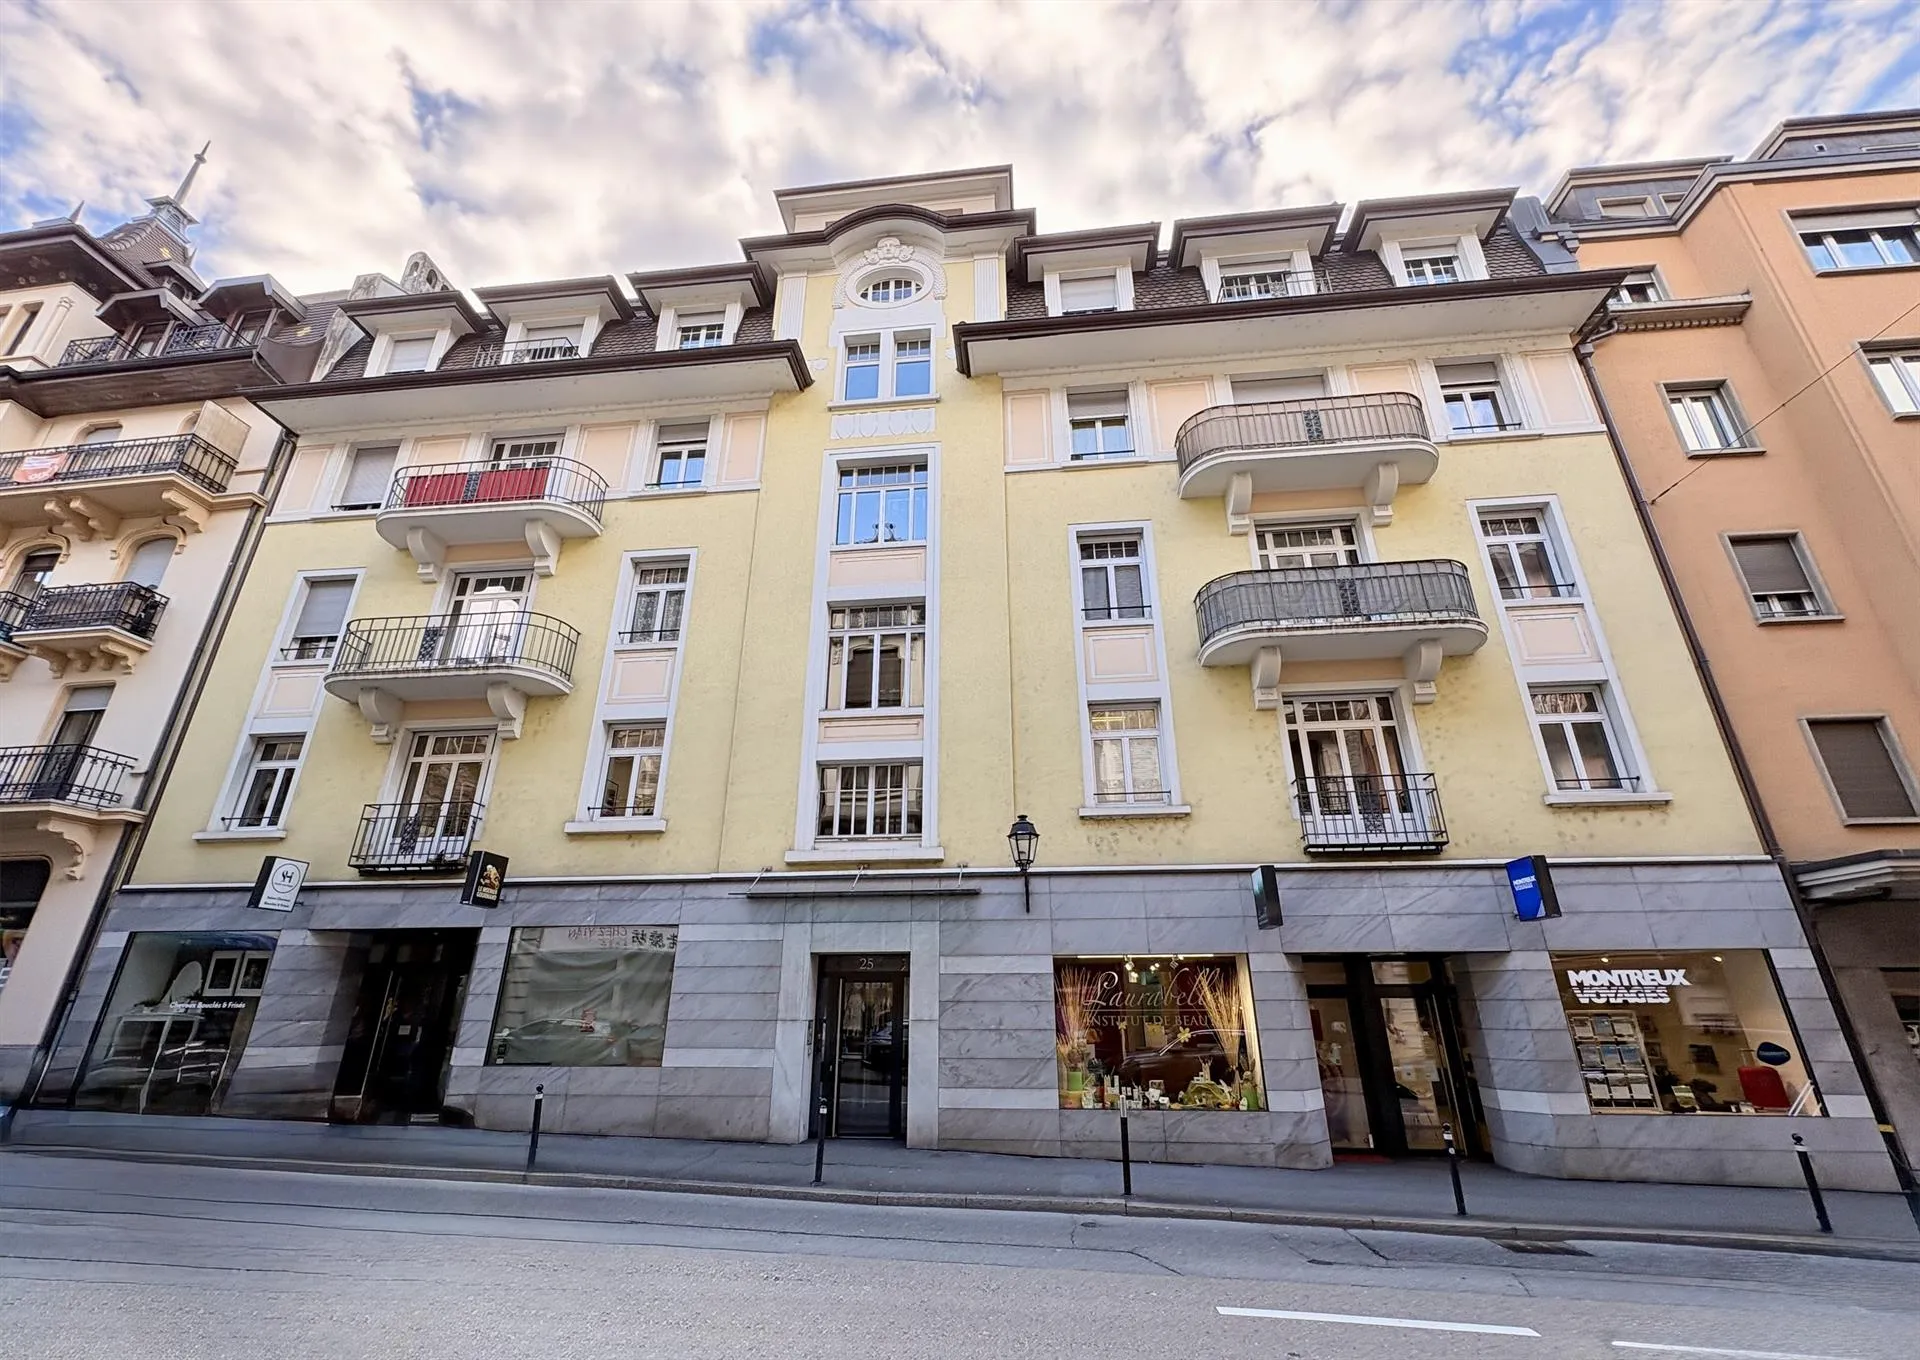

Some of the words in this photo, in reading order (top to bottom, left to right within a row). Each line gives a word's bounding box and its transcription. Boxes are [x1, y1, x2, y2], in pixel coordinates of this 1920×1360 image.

[859, 958, 874, 970] 25
[1567, 969, 1692, 986] MONTREUX
[1083, 967, 1221, 1007] Laurabell
[1571, 987, 1671, 1004] VOYAGES
[1153, 1015, 1170, 1026] DE
[1175, 1015, 1209, 1026] BEAU
